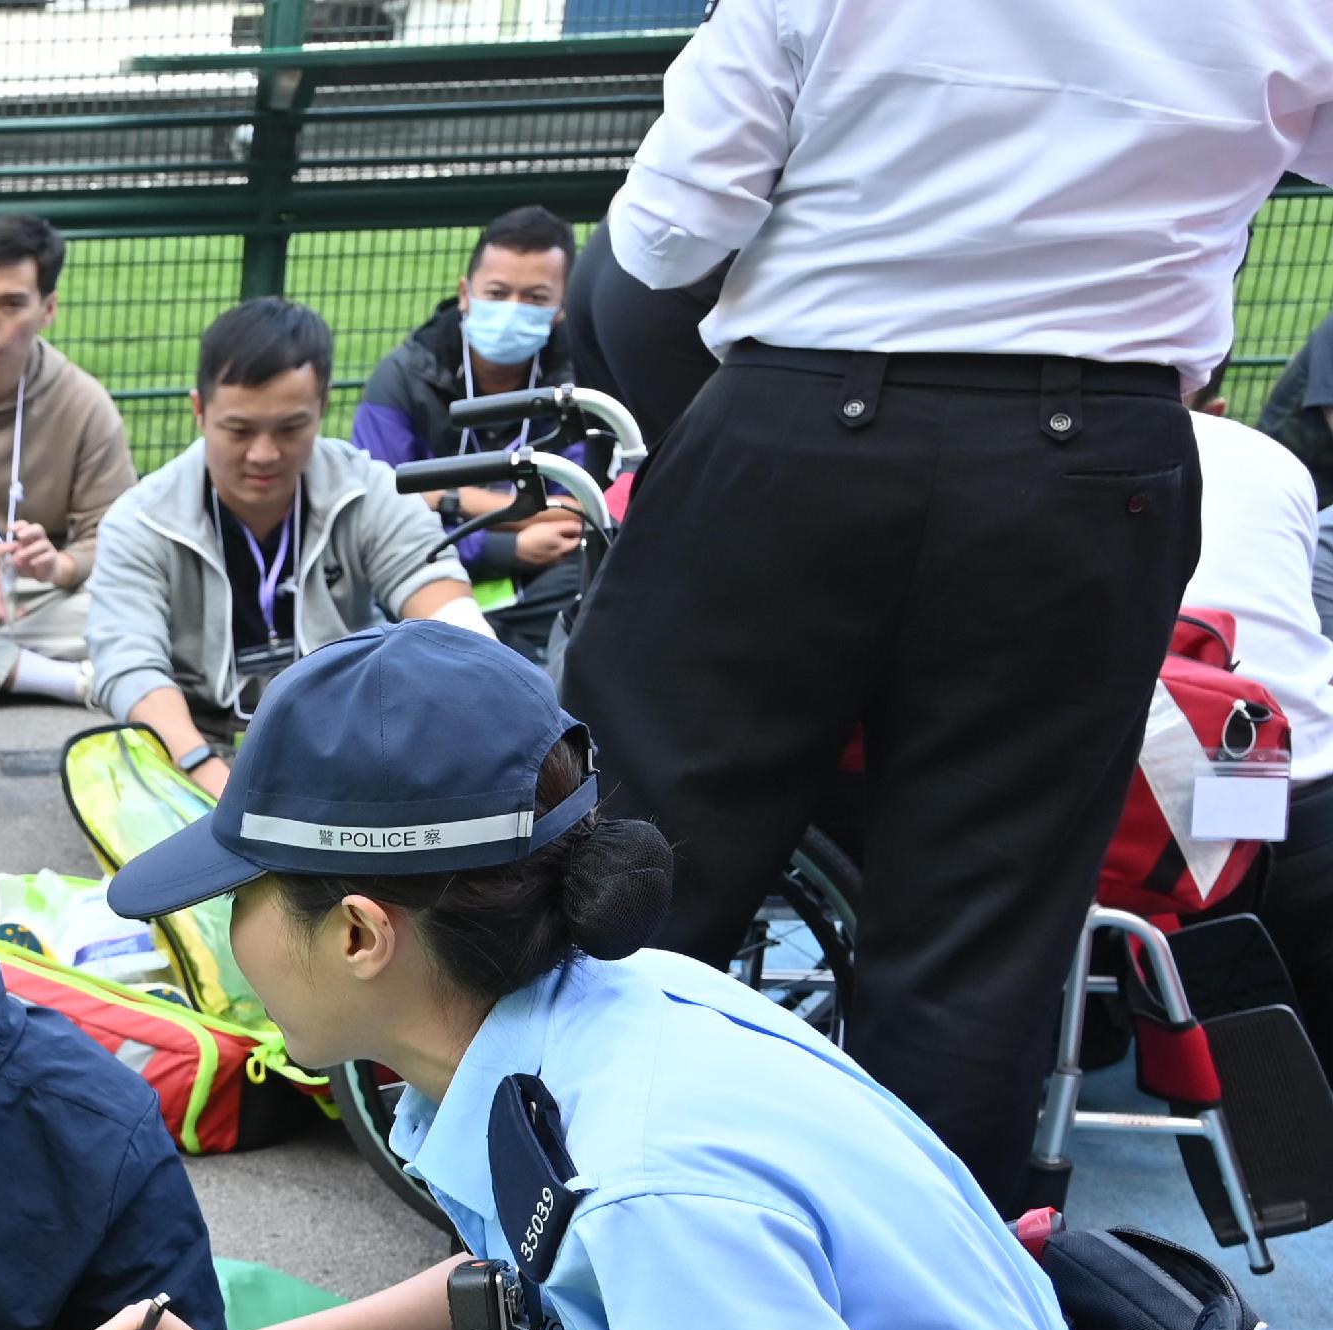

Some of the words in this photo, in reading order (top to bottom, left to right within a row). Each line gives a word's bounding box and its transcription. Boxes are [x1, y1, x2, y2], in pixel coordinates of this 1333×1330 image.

[340, 831, 417, 848] POLICE
[423, 828, 442, 846] 察
[520, 1186, 555, 1262] 35039
